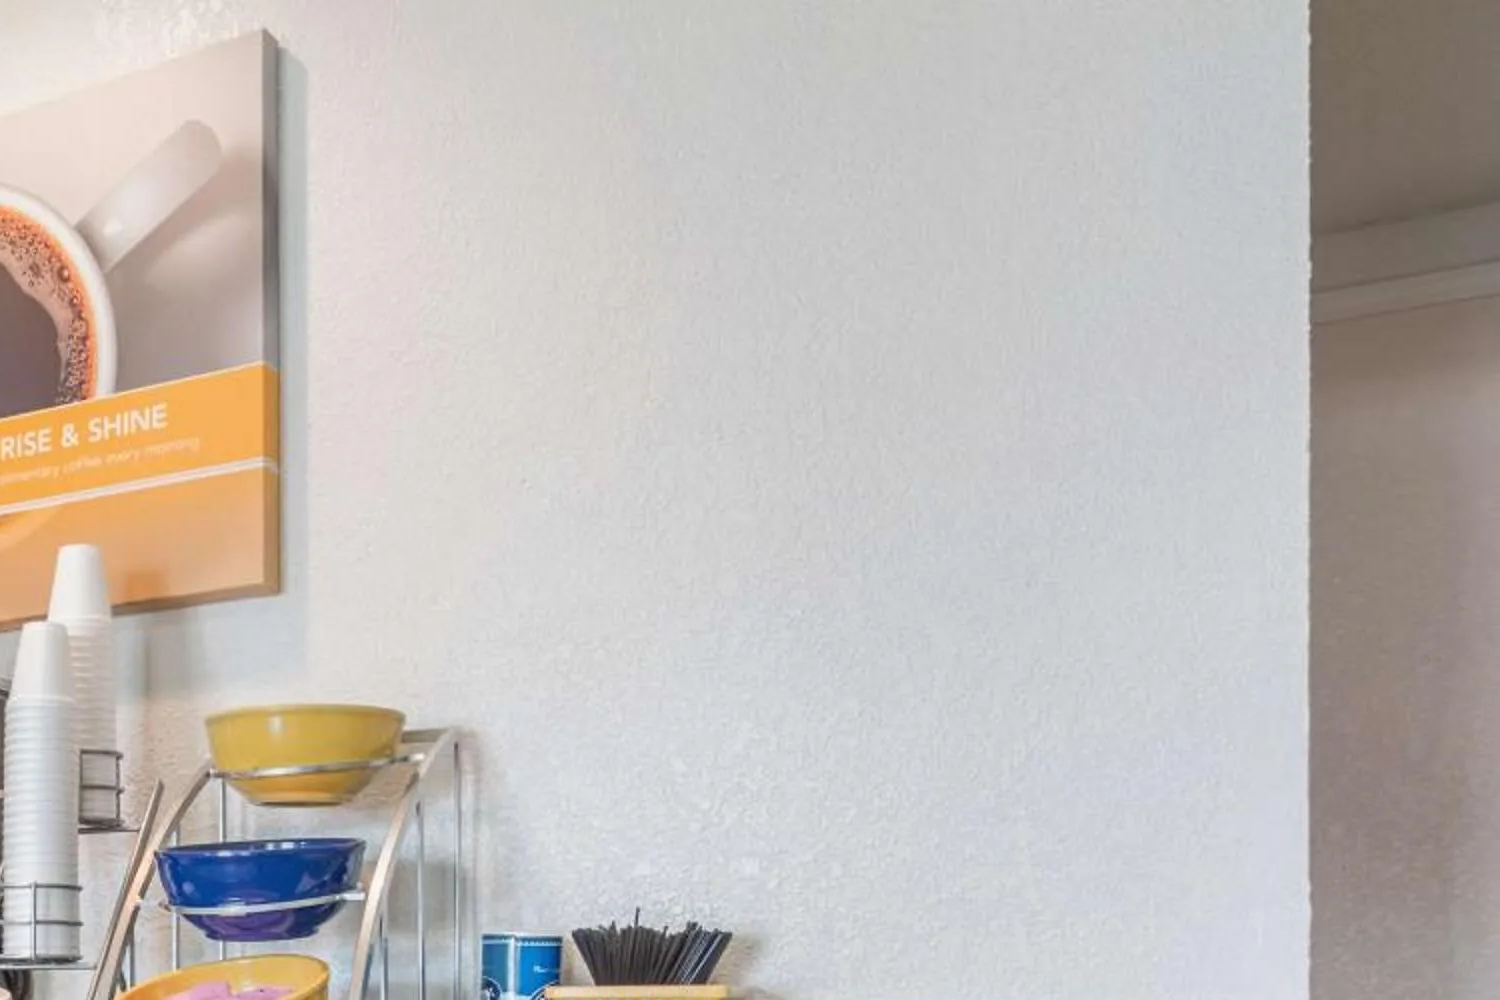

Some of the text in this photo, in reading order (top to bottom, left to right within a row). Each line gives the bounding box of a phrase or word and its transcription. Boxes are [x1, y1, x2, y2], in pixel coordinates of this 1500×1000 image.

[0, 402, 168, 461] RISE & SHINE
[105, 448, 140, 466] every
